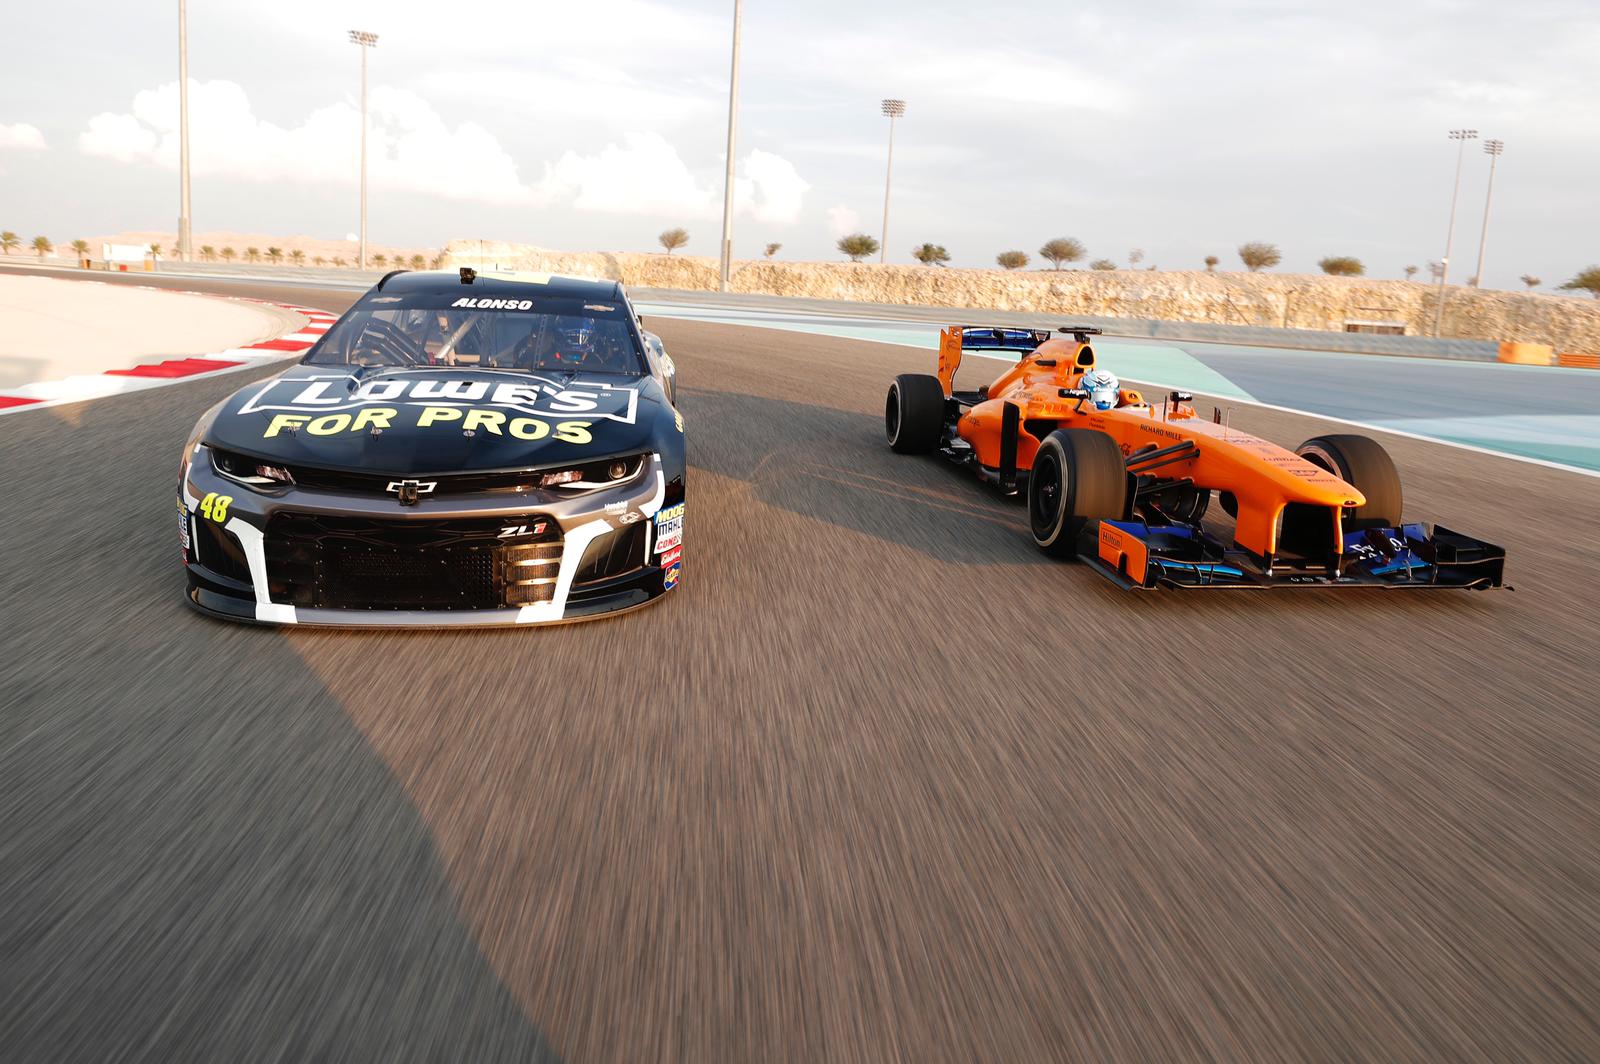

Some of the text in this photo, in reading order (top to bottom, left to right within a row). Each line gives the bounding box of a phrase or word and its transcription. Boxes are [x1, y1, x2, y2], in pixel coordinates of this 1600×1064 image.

[451, 297, 533, 310] ALONSO
[291, 379, 599, 412] LOWE'S
[264, 407, 593, 444] FOR PROS
[200, 492, 234, 523] 48
[658, 503, 685, 522] MOOG
[497, 522, 547, 538] ZL1
[1103, 531, 1121, 546] Hilton
